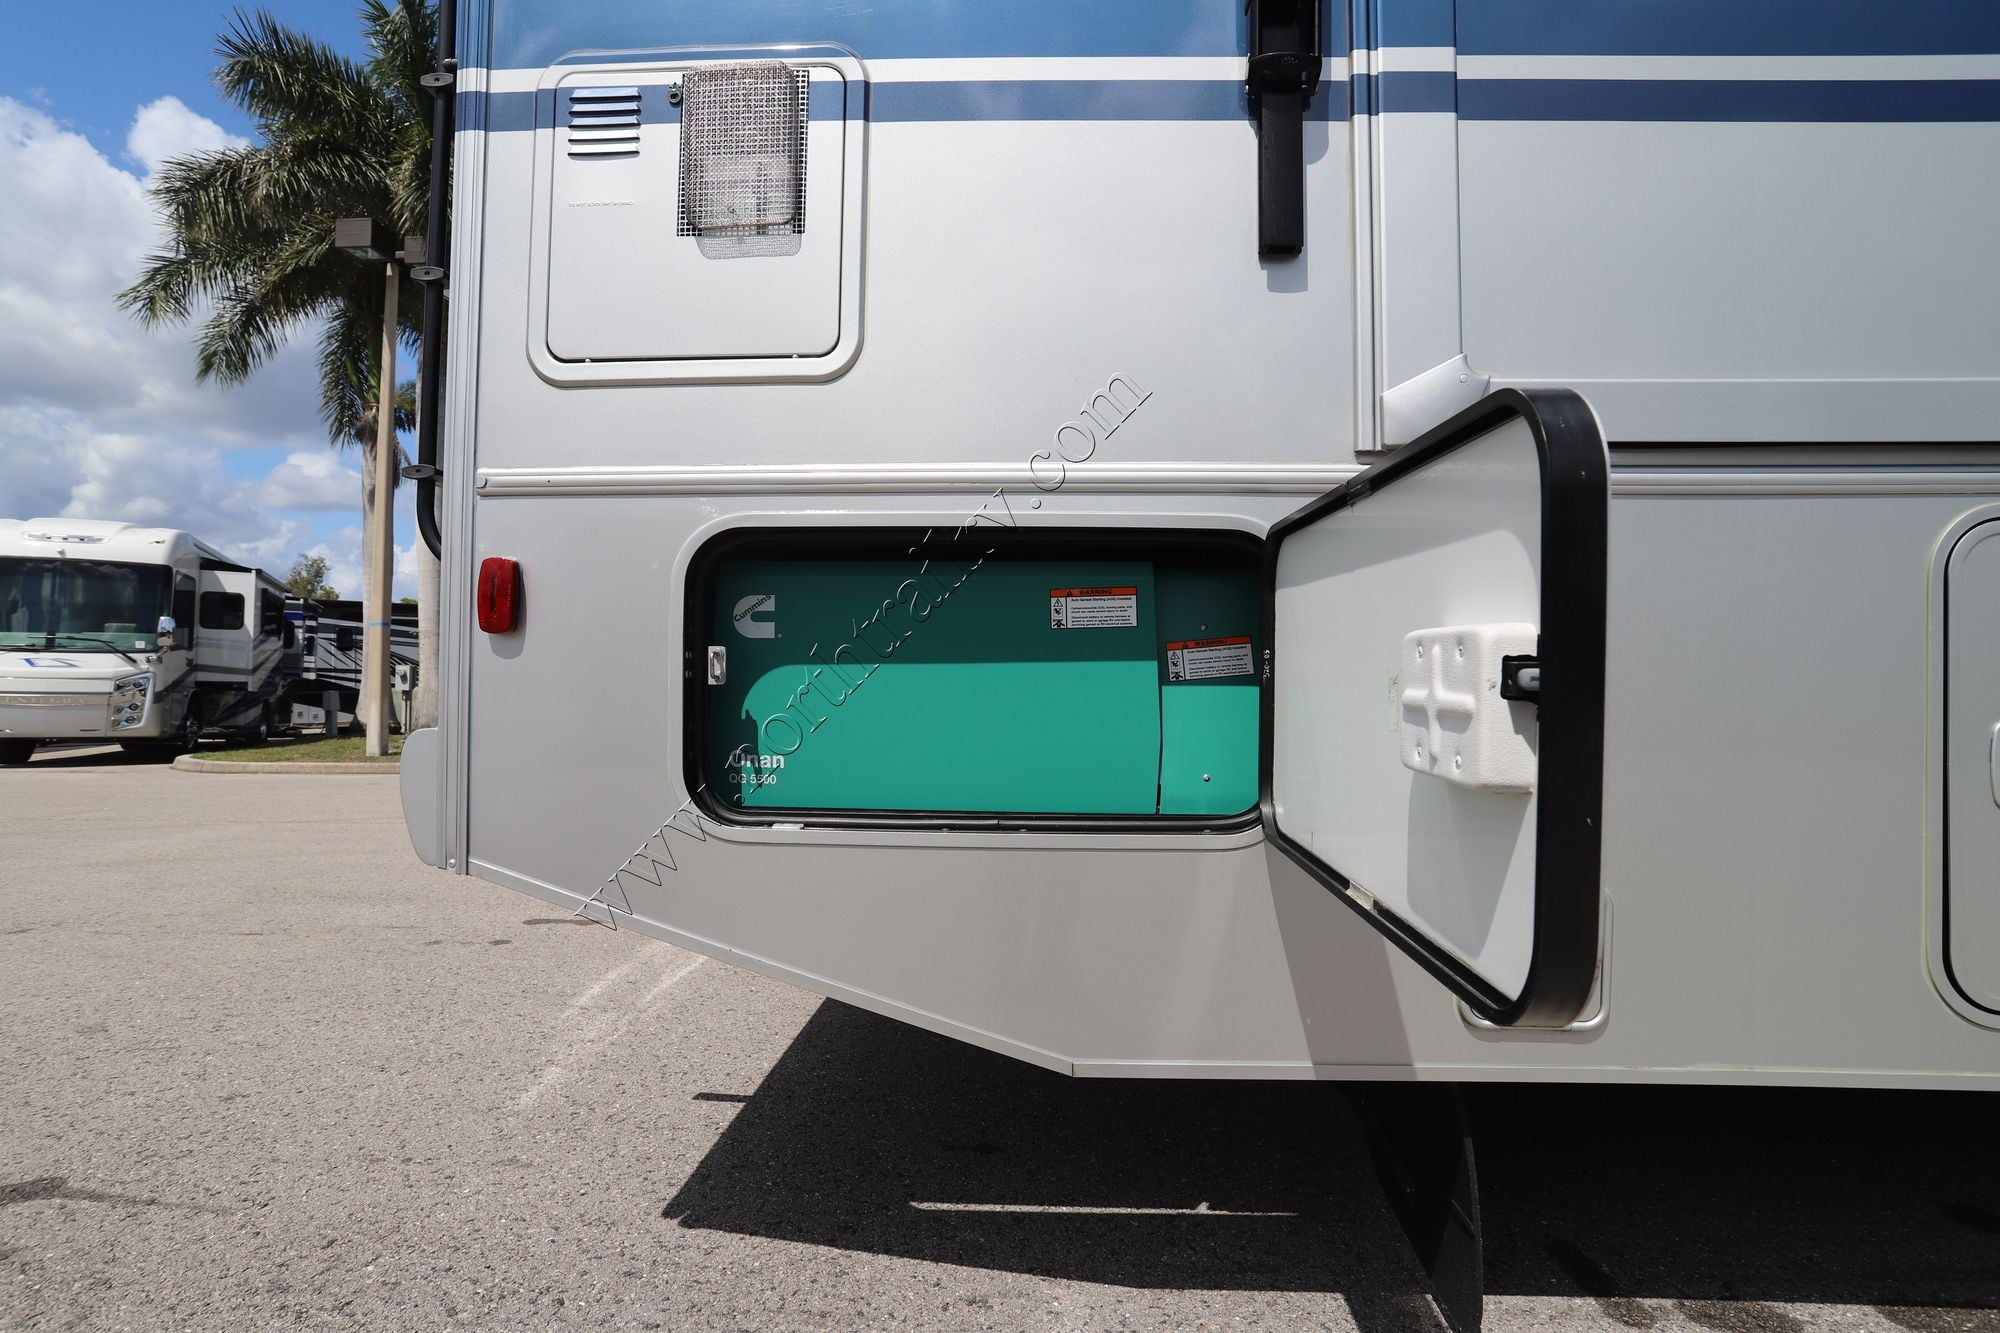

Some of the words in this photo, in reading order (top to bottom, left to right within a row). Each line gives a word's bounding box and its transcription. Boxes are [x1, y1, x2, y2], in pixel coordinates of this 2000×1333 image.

[734, 594, 772, 622] Cummins
[730, 750, 785, 769] Onan
[729, 773, 747, 784] QG
[750, 774, 777, 785] 5500
